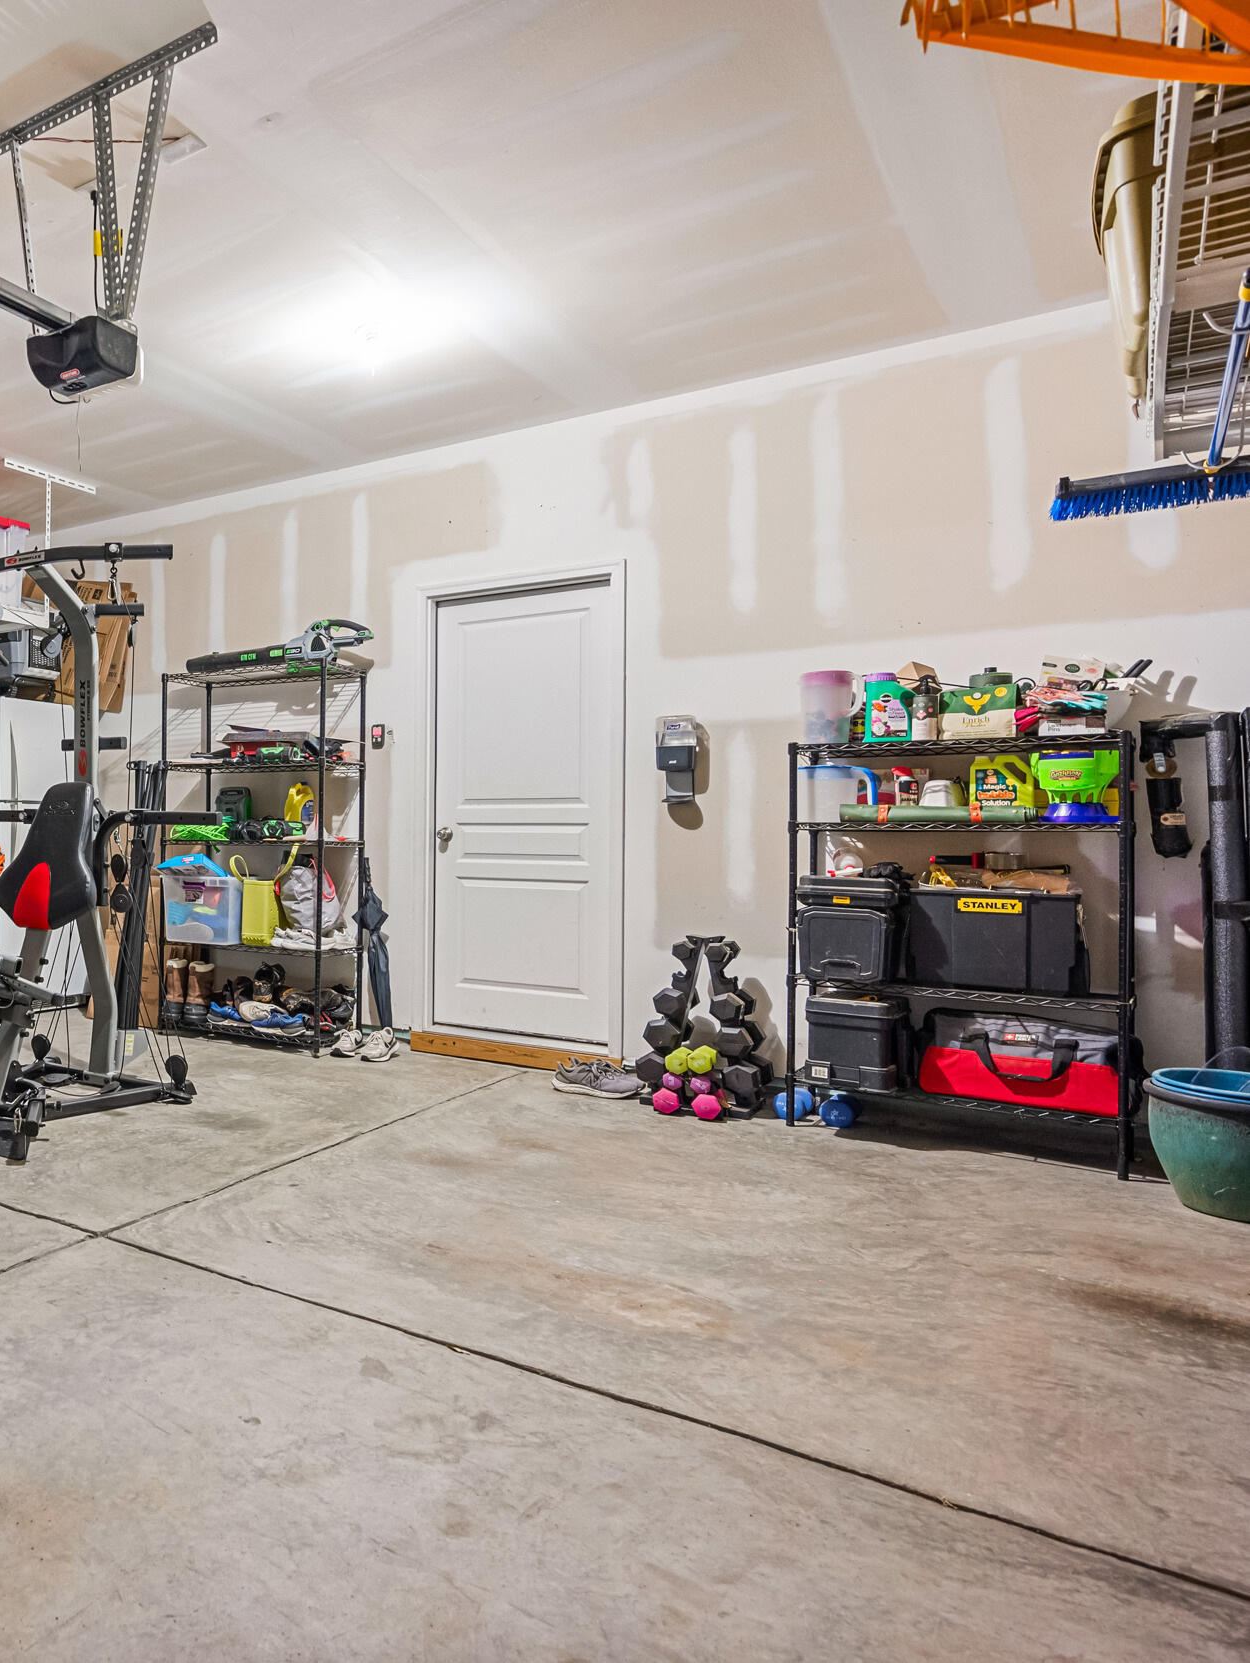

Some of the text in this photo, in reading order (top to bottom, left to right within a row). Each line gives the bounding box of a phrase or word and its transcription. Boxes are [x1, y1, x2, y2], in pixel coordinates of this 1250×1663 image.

[982, 783, 1007, 791] Magic
[977, 790, 1015, 800] bubble
[981, 799, 1011, 807] Solution
[962, 901, 1017, 911] STANLEY
